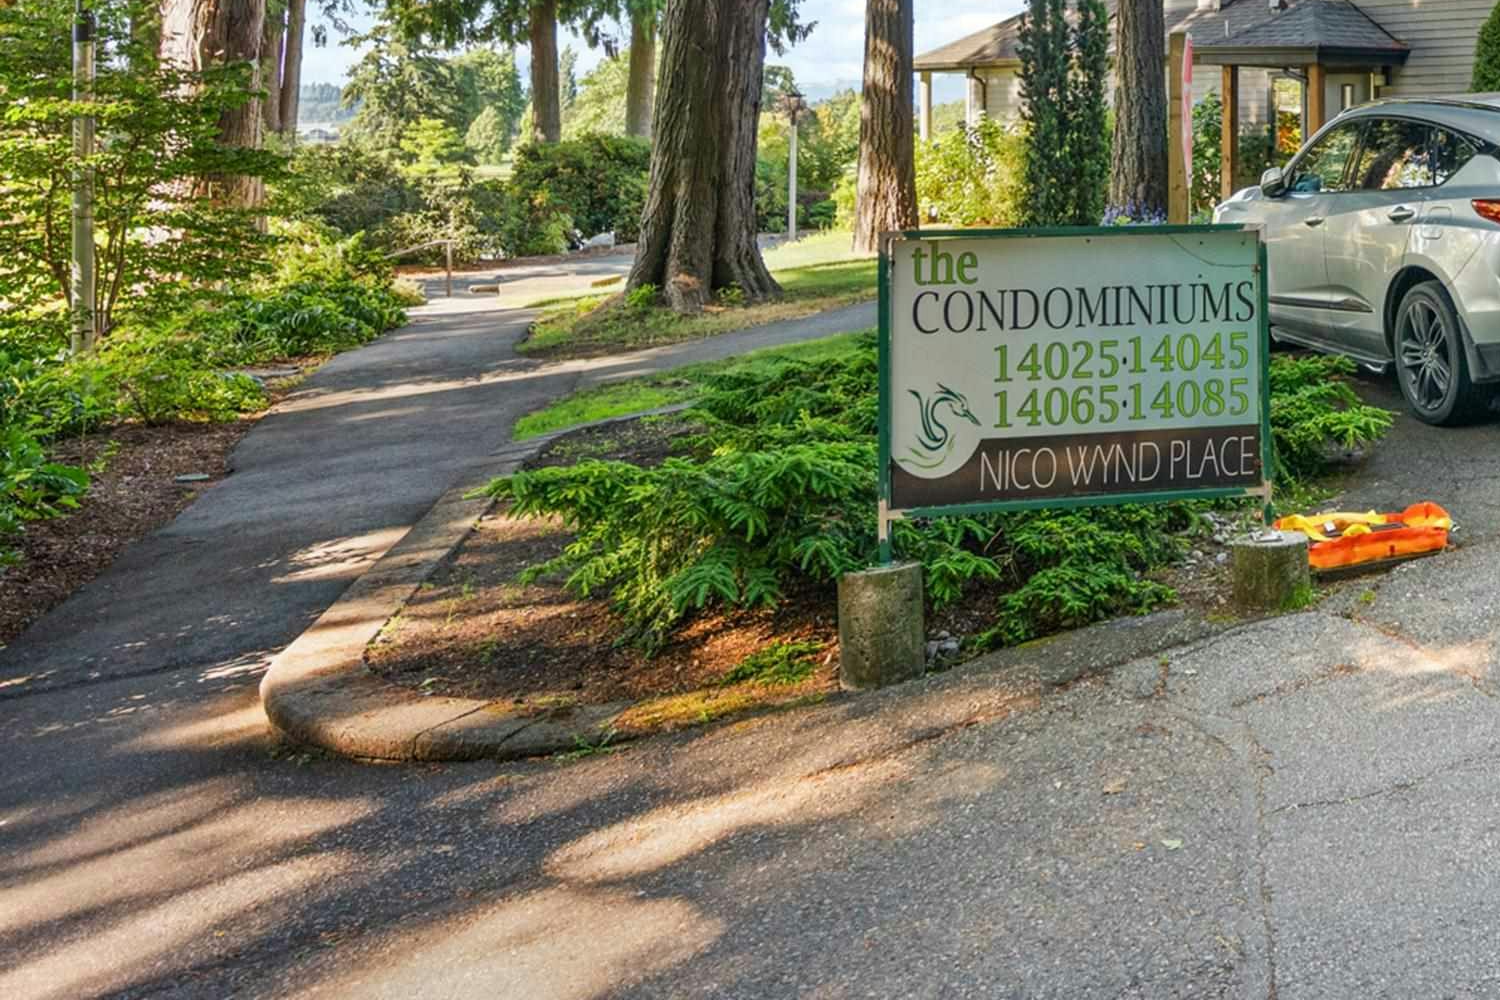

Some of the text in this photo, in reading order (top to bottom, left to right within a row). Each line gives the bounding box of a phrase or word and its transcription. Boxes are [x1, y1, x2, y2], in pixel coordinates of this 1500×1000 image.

[911, 240, 979, 286] the
[911, 280, 1255, 335] CONDOMINIUMS
[979, 435, 1256, 492] NICO WYND PLACE
